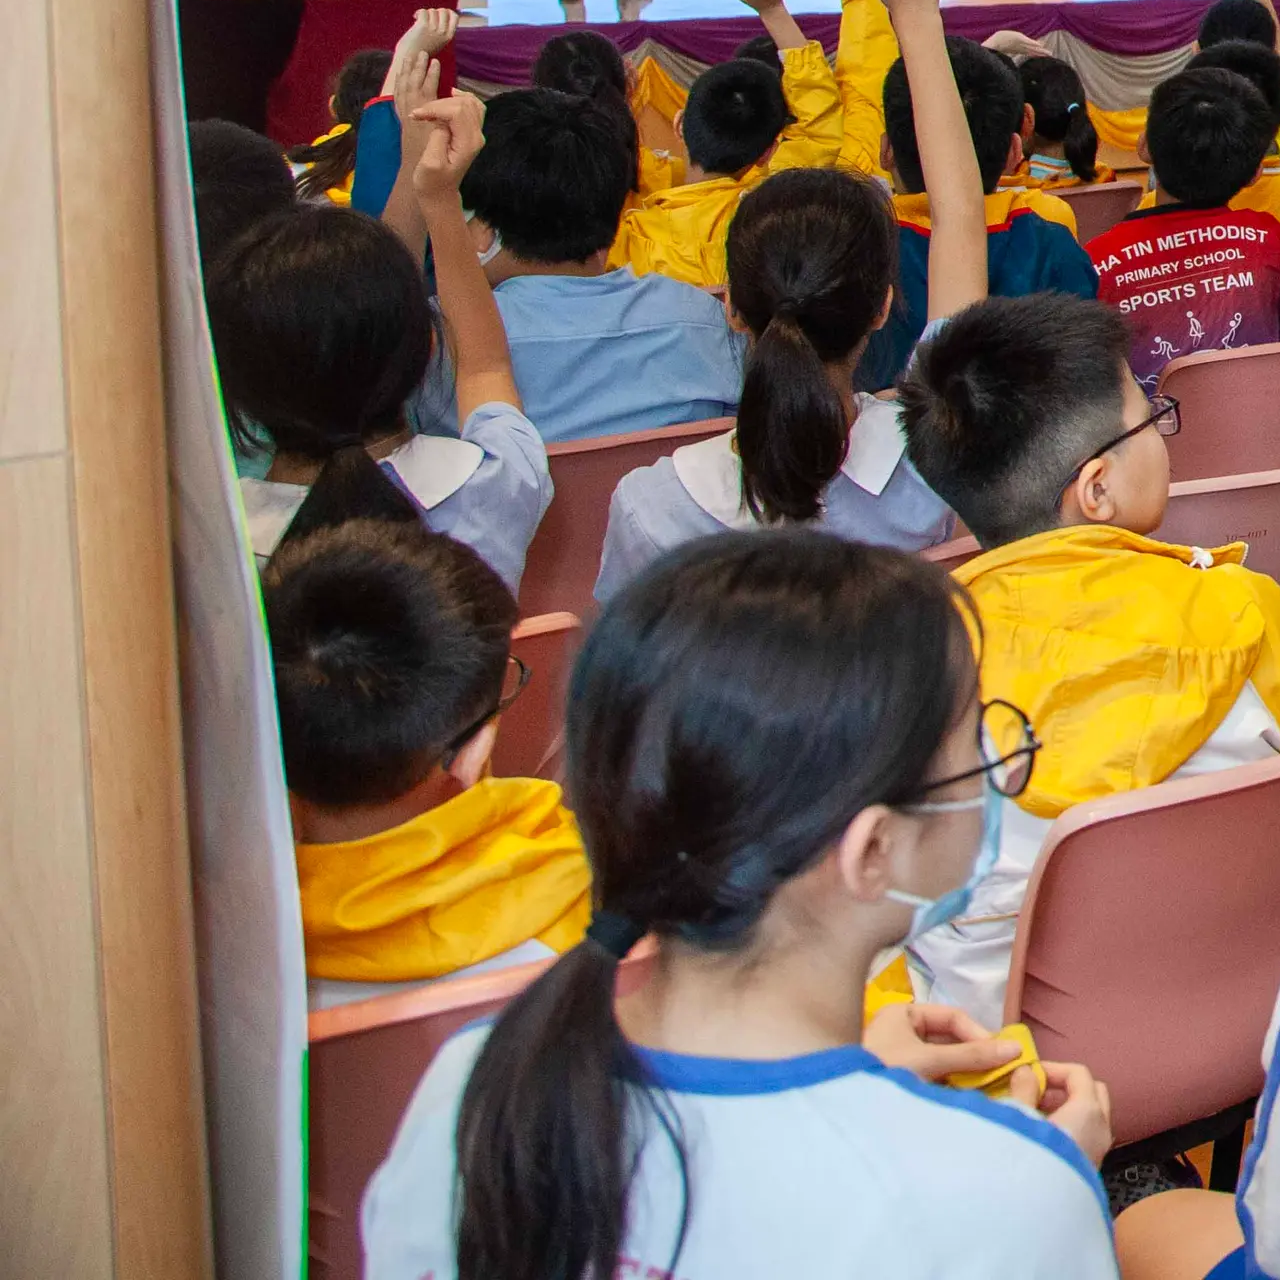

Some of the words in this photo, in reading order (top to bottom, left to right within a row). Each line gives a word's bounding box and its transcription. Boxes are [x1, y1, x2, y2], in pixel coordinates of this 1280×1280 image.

[1093, 253, 1122, 276] HA
[1121, 240, 1153, 261] TIN
[1157, 225, 1268, 252] METHODIST
[1115, 260, 1180, 287] PRIMARY
[1184, 247, 1245, 270] SCHOOL
[1119, 282, 1195, 314] SPORTS
[1200, 271, 1253, 294] TEAM
